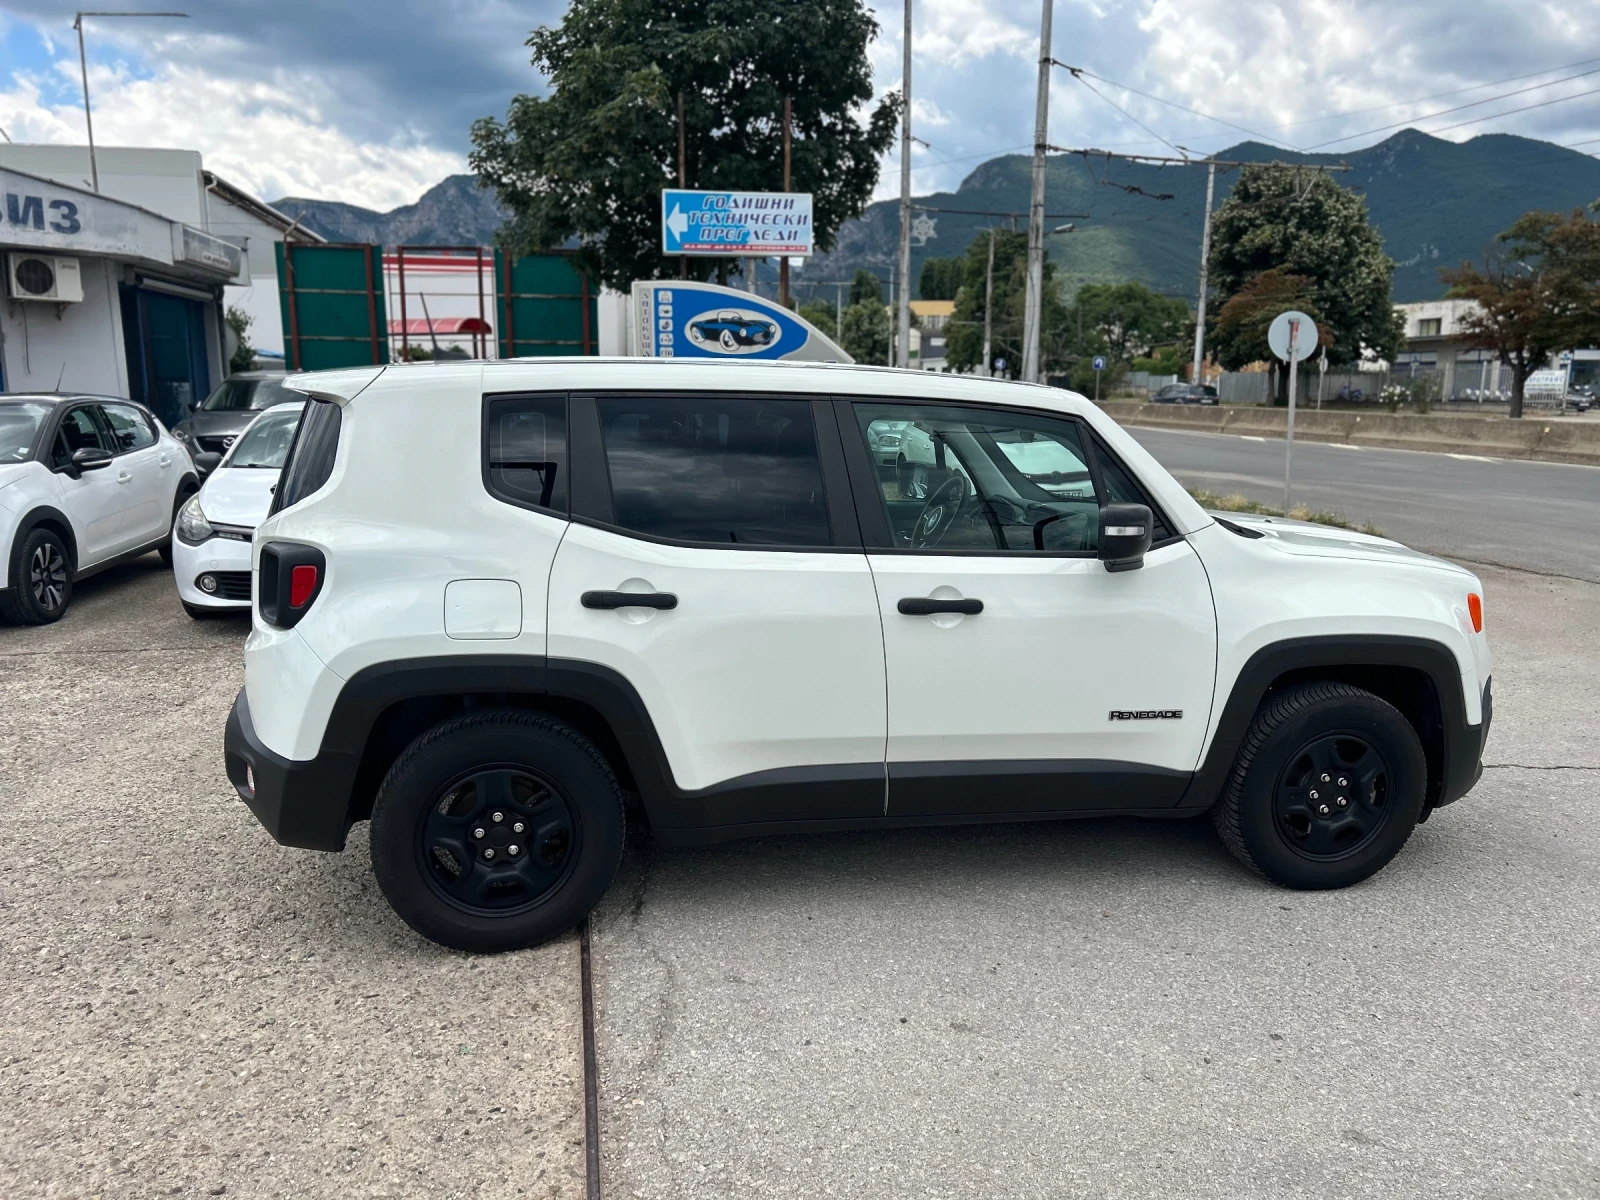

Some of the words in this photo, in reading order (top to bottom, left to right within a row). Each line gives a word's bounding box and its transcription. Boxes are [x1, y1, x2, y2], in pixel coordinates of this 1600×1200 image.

[703, 196, 795, 210] ГОДИШНИ
[0, 193, 81, 235] ИЗ
[690, 211, 808, 226] ТЕХНИЧЕСКИ
[701, 227, 799, 241] ПРЕГЛЕДИ
[1108, 710, 1183, 720] RENEGADE
